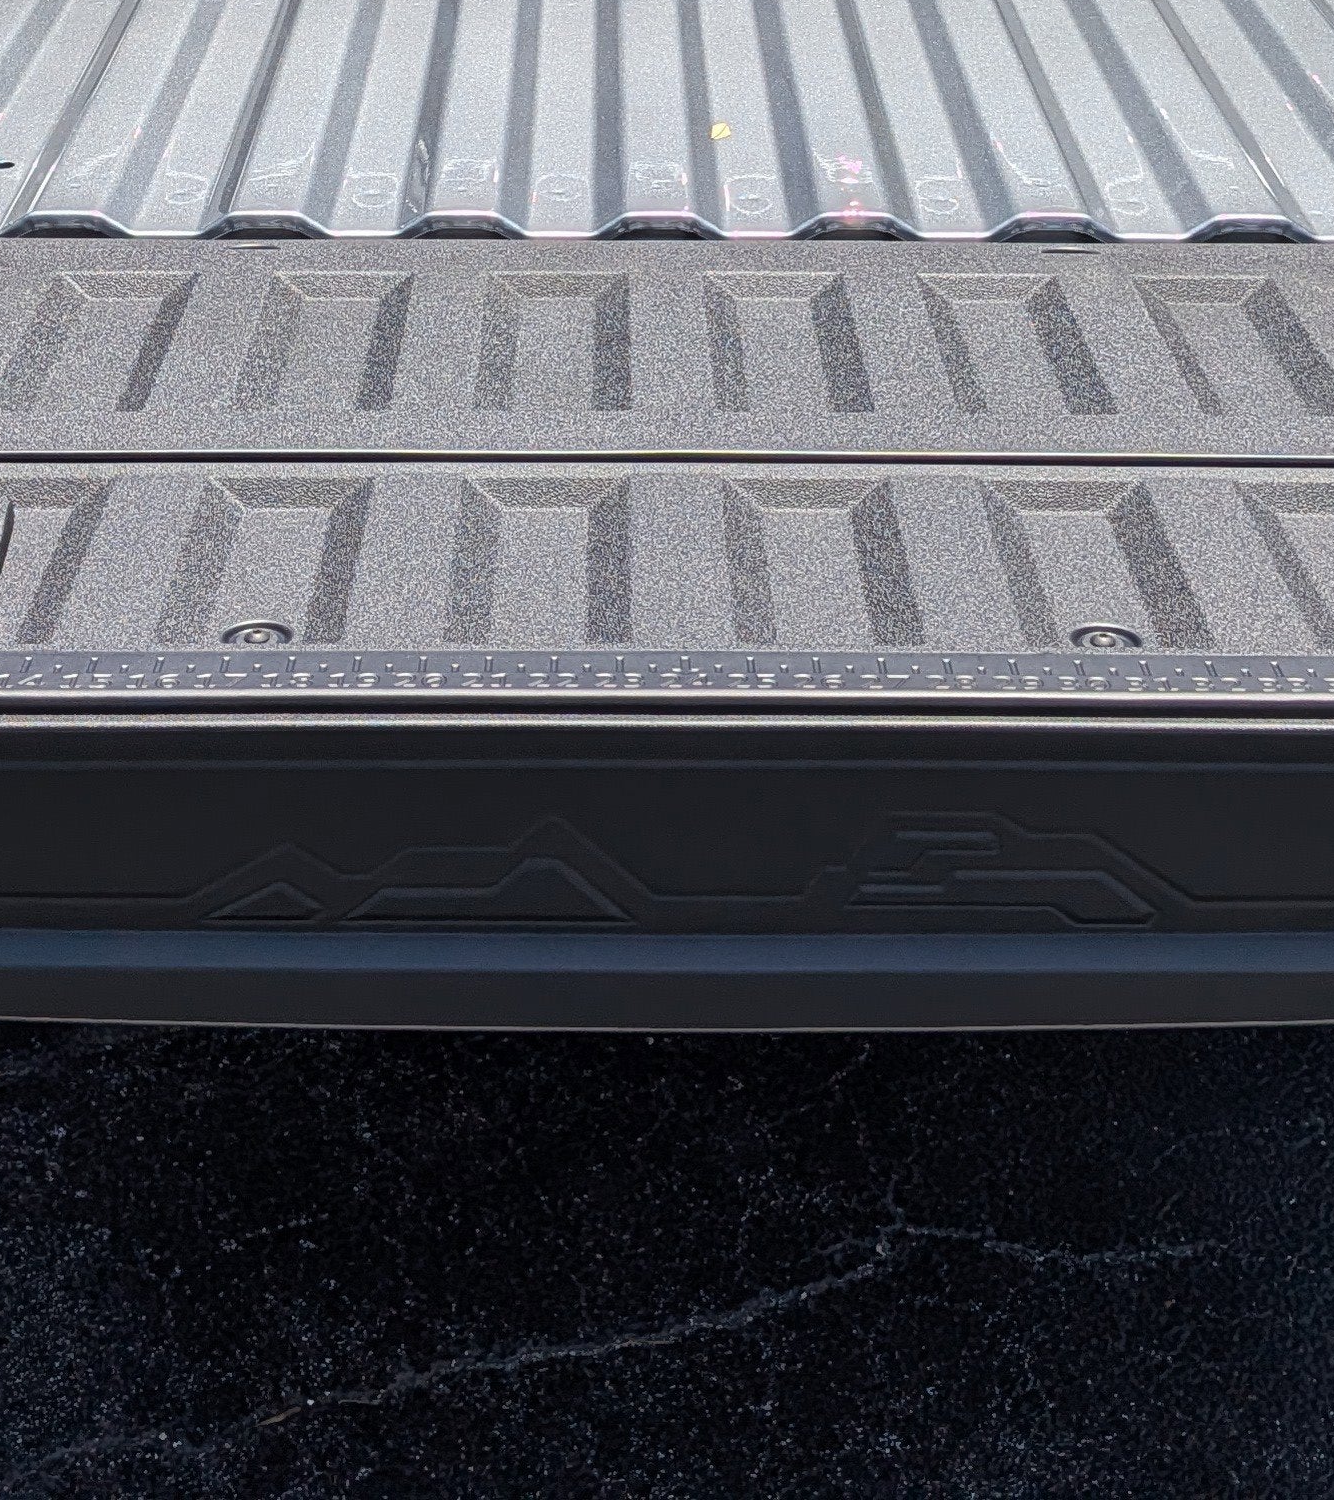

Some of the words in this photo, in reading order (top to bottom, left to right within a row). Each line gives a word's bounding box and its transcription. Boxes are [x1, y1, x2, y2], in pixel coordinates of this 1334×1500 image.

[59, 673, 111, 688] 15
[126, 673, 180, 688] 16
[193, 673, 248, 688] 17
[260, 673, 312, 688] 18
[327, 673, 380, 688] 19
[394, 673, 447, 688] 20
[461, 673, 513, 688] 21
[528, 673, 579, 688] 22
[595, 673, 644, 688] 23
[660, 673, 713, 688] 24
[727, 673, 777, 688] 25
[793, 673, 845, 688] 26
[859, 674, 910, 688] 27
[925, 674, 977, 688] 28
[992, 675, 1044, 689] 29
[1058, 676, 1111, 690] 30
[1124, 676, 1179, 690] 31
[1191, 676, 1242, 691] 32
